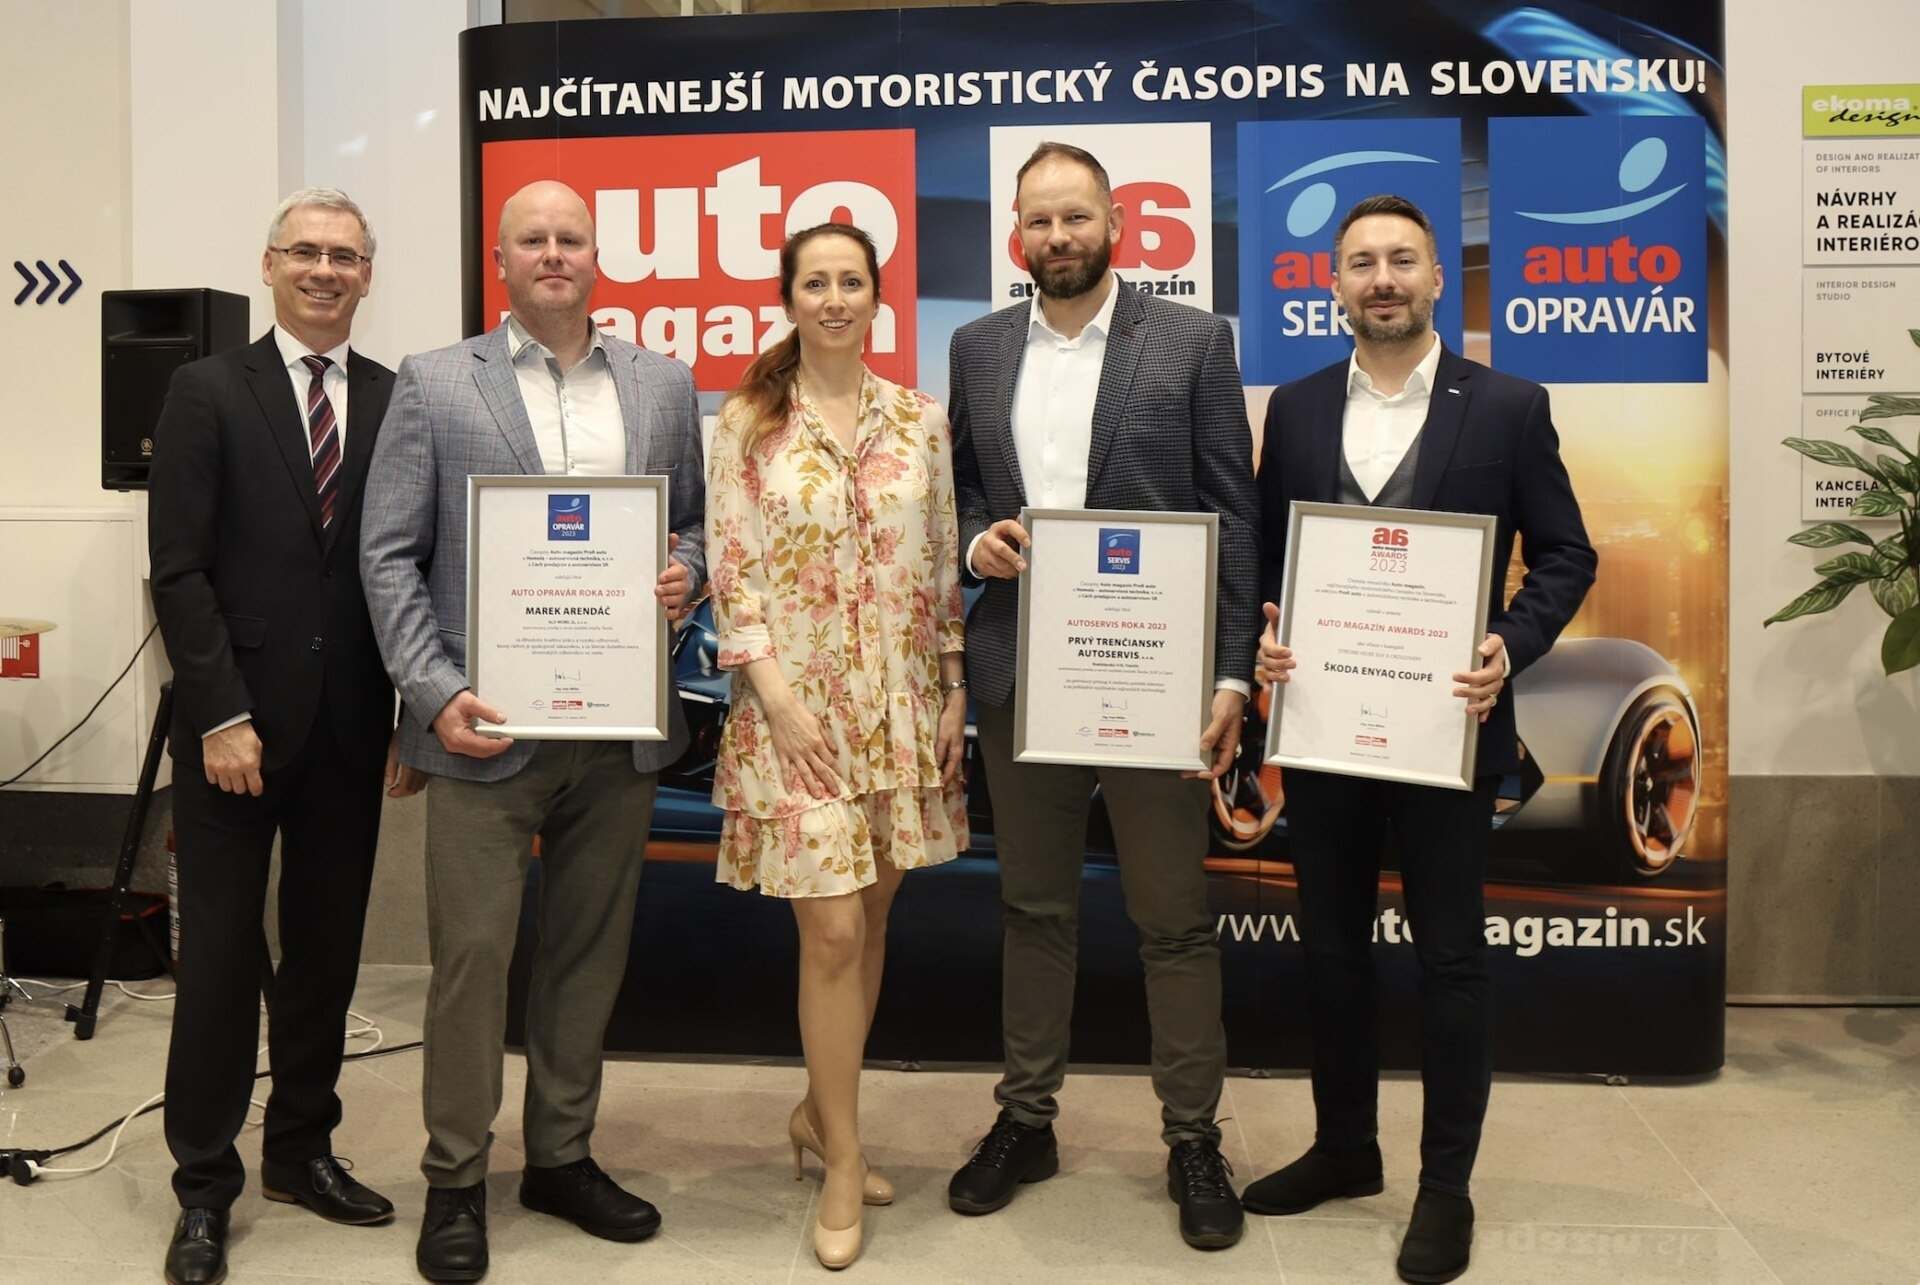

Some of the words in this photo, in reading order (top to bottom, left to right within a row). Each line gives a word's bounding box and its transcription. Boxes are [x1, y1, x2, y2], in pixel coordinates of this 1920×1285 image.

[480, 71, 764, 121] NAJČÍTANEJŠÍ
[783, 61, 1112, 110] MOTORISTICKÝ
[1132, 60, 1325, 101] ČASOPIS
[1346, 62, 1410, 97] NA
[1430, 58, 1706, 96] SLOVENSKU!
[1812, 95, 1910, 112] ekoma
[1816, 153, 1851, 161] DESIGN
[1854, 153, 1874, 161] AND
[1832, 165, 1881, 173] INTERIORS
[1816, 188, 1897, 206] NÁVRHY
[1816, 215, 1830, 229] A
[1838, 210, 1920, 229] REALIZÁ
[1523, 235, 1682, 284] auto
[1816, 280, 1859, 289] INTERIOR
[1861, 280, 1896, 289] DESIGN
[1816, 292, 1851, 301] STUDIO
[1505, 284, 1697, 334] OPRAVÁR
[1282, 300, 1354, 337] SER
[1816, 349, 1870, 363] BYTOVÉ
[1816, 366, 1885, 380] INTERIÉRY
[1816, 409, 1850, 417] OFFICE
[1816, 480, 1879, 491] KANCELA
[1370, 550, 1408, 560] AWARDS
[1369, 558, 1407, 574] 2023
[511, 589, 534, 597] AUTO
[536, 588, 577, 597] OPRAVÁR
[578, 589, 604, 597] ROKA
[606, 589, 626, 597] 2023
[526, 607, 560, 616] MAREK
[563, 605, 611, 616] ARENDÁČ
[1066, 620, 1119, 629] AUTOSERVIS
[1147, 622, 1168, 630] 2023
[1317, 618, 1342, 628] AUTO
[1388, 626, 1426, 636] AWARDS
[1428, 629, 1448, 638] 2023
[1068, 636, 1094, 645] PRVÝ
[1096, 638, 1165, 648] TRENČIANSKY
[1324, 662, 1359, 674] ŠKODA
[1361, 667, 1396, 679] ENYAQ
[1398, 671, 1433, 682] COUPÉ
